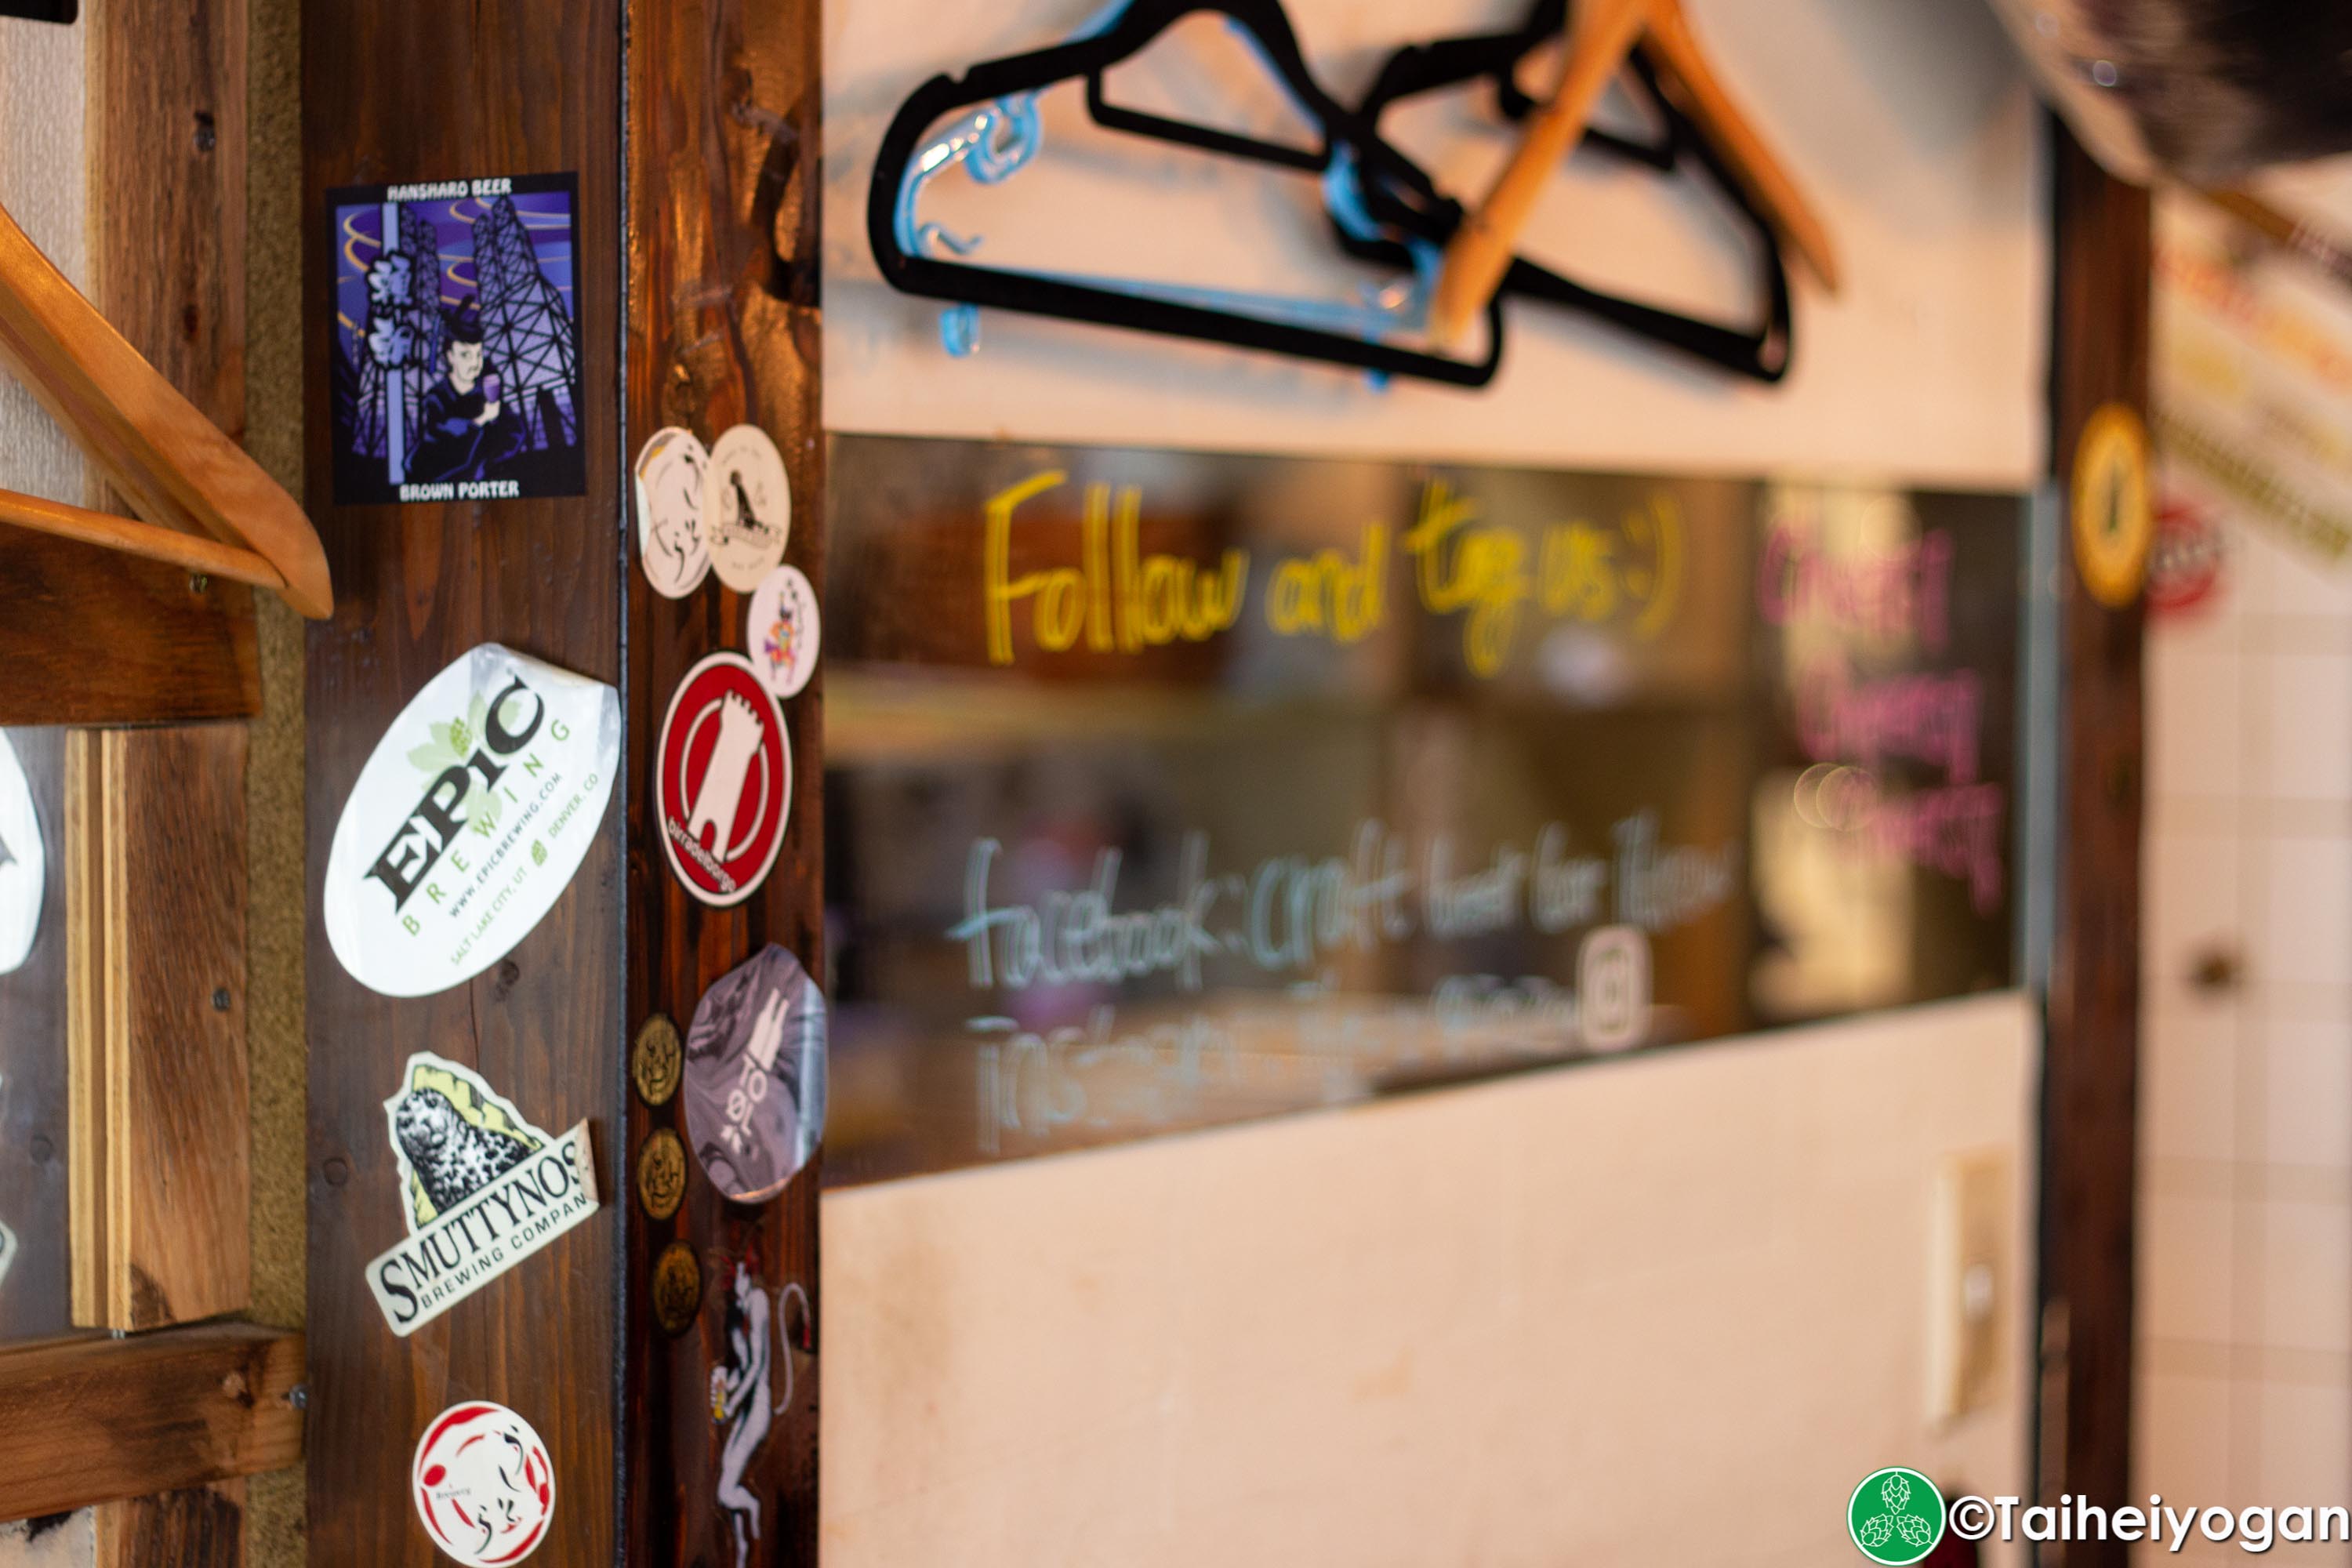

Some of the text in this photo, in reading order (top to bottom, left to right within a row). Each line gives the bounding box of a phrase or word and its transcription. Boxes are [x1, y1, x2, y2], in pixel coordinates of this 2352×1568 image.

[471, 178, 512, 197] BEER
[399, 480, 519, 502] BROWN PORTER
[985, 470, 1250, 665] Follow
[1266, 521, 1389, 644] and
[402, 719, 570, 937] BREWING
[420, 1248, 504, 1308] BREWING
